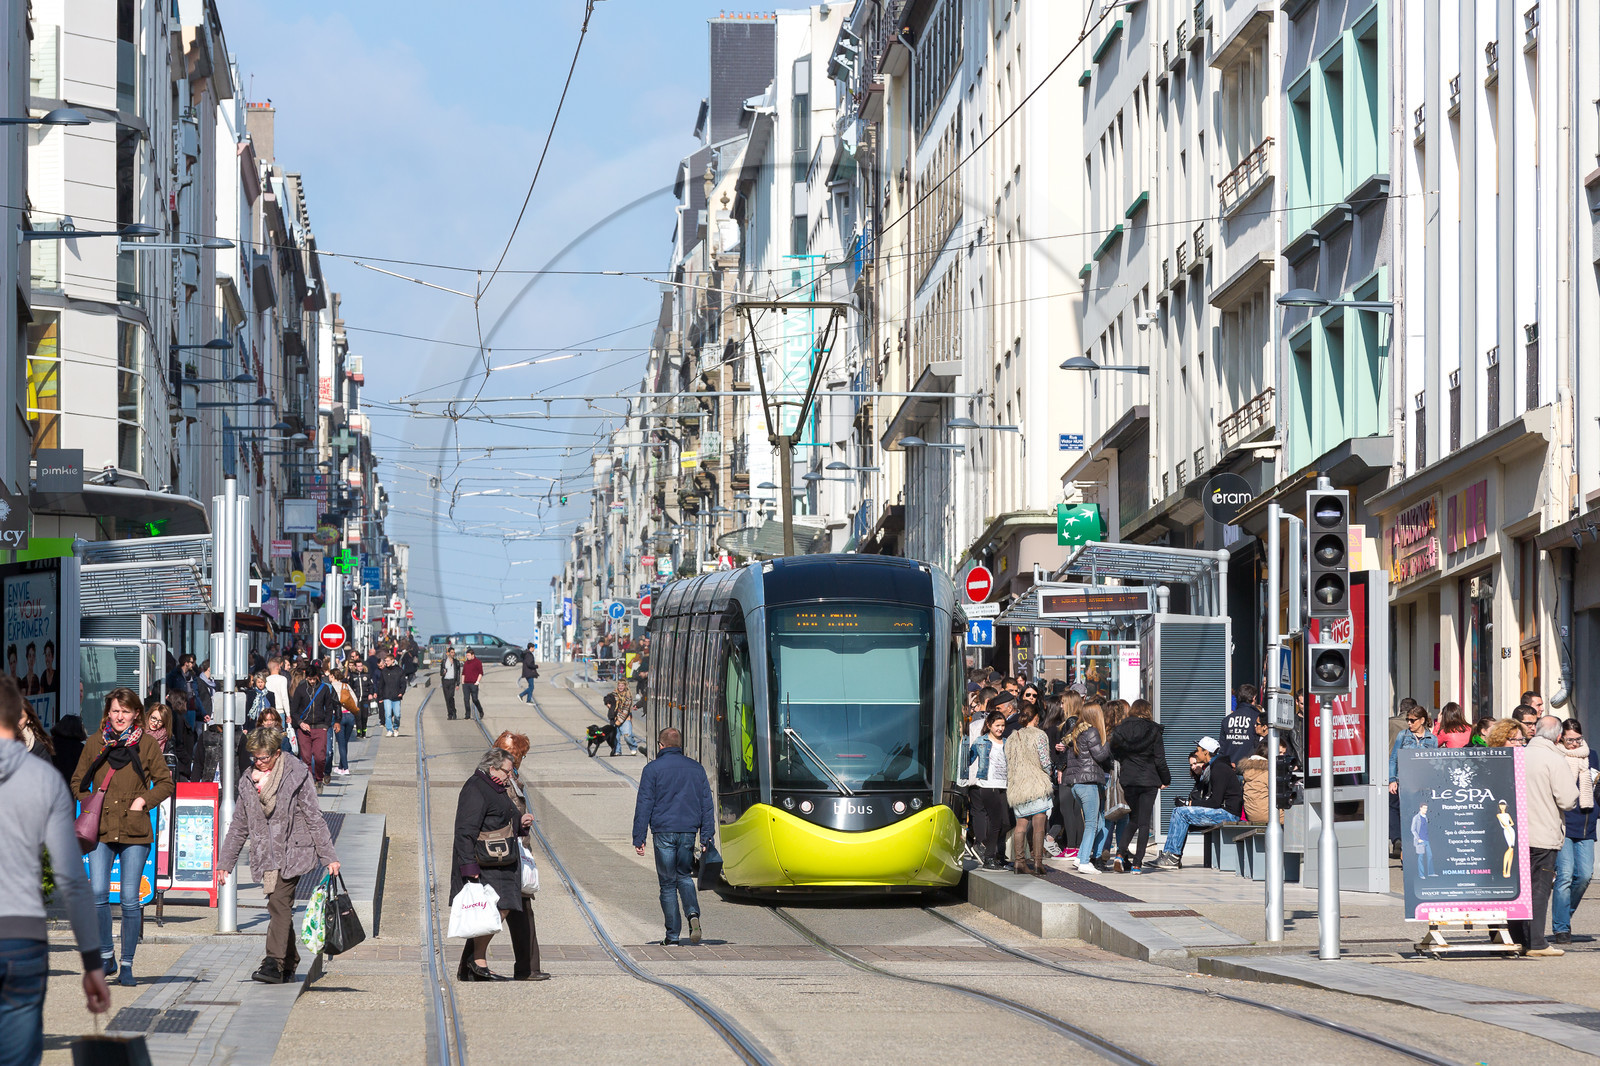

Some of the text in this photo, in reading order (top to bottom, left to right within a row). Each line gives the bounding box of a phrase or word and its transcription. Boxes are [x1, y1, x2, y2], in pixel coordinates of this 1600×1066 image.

[41, 464, 79, 477] pimkie
[1212, 488, 1252, 505] éram
[8, 581, 30, 602] ENVIE
[8, 599, 42, 622] DE VOUS
[1330, 620, 1350, 644] ING
[1228, 716, 1251, 728] DEUS
[1431, 788, 1496, 803] LE SPA
